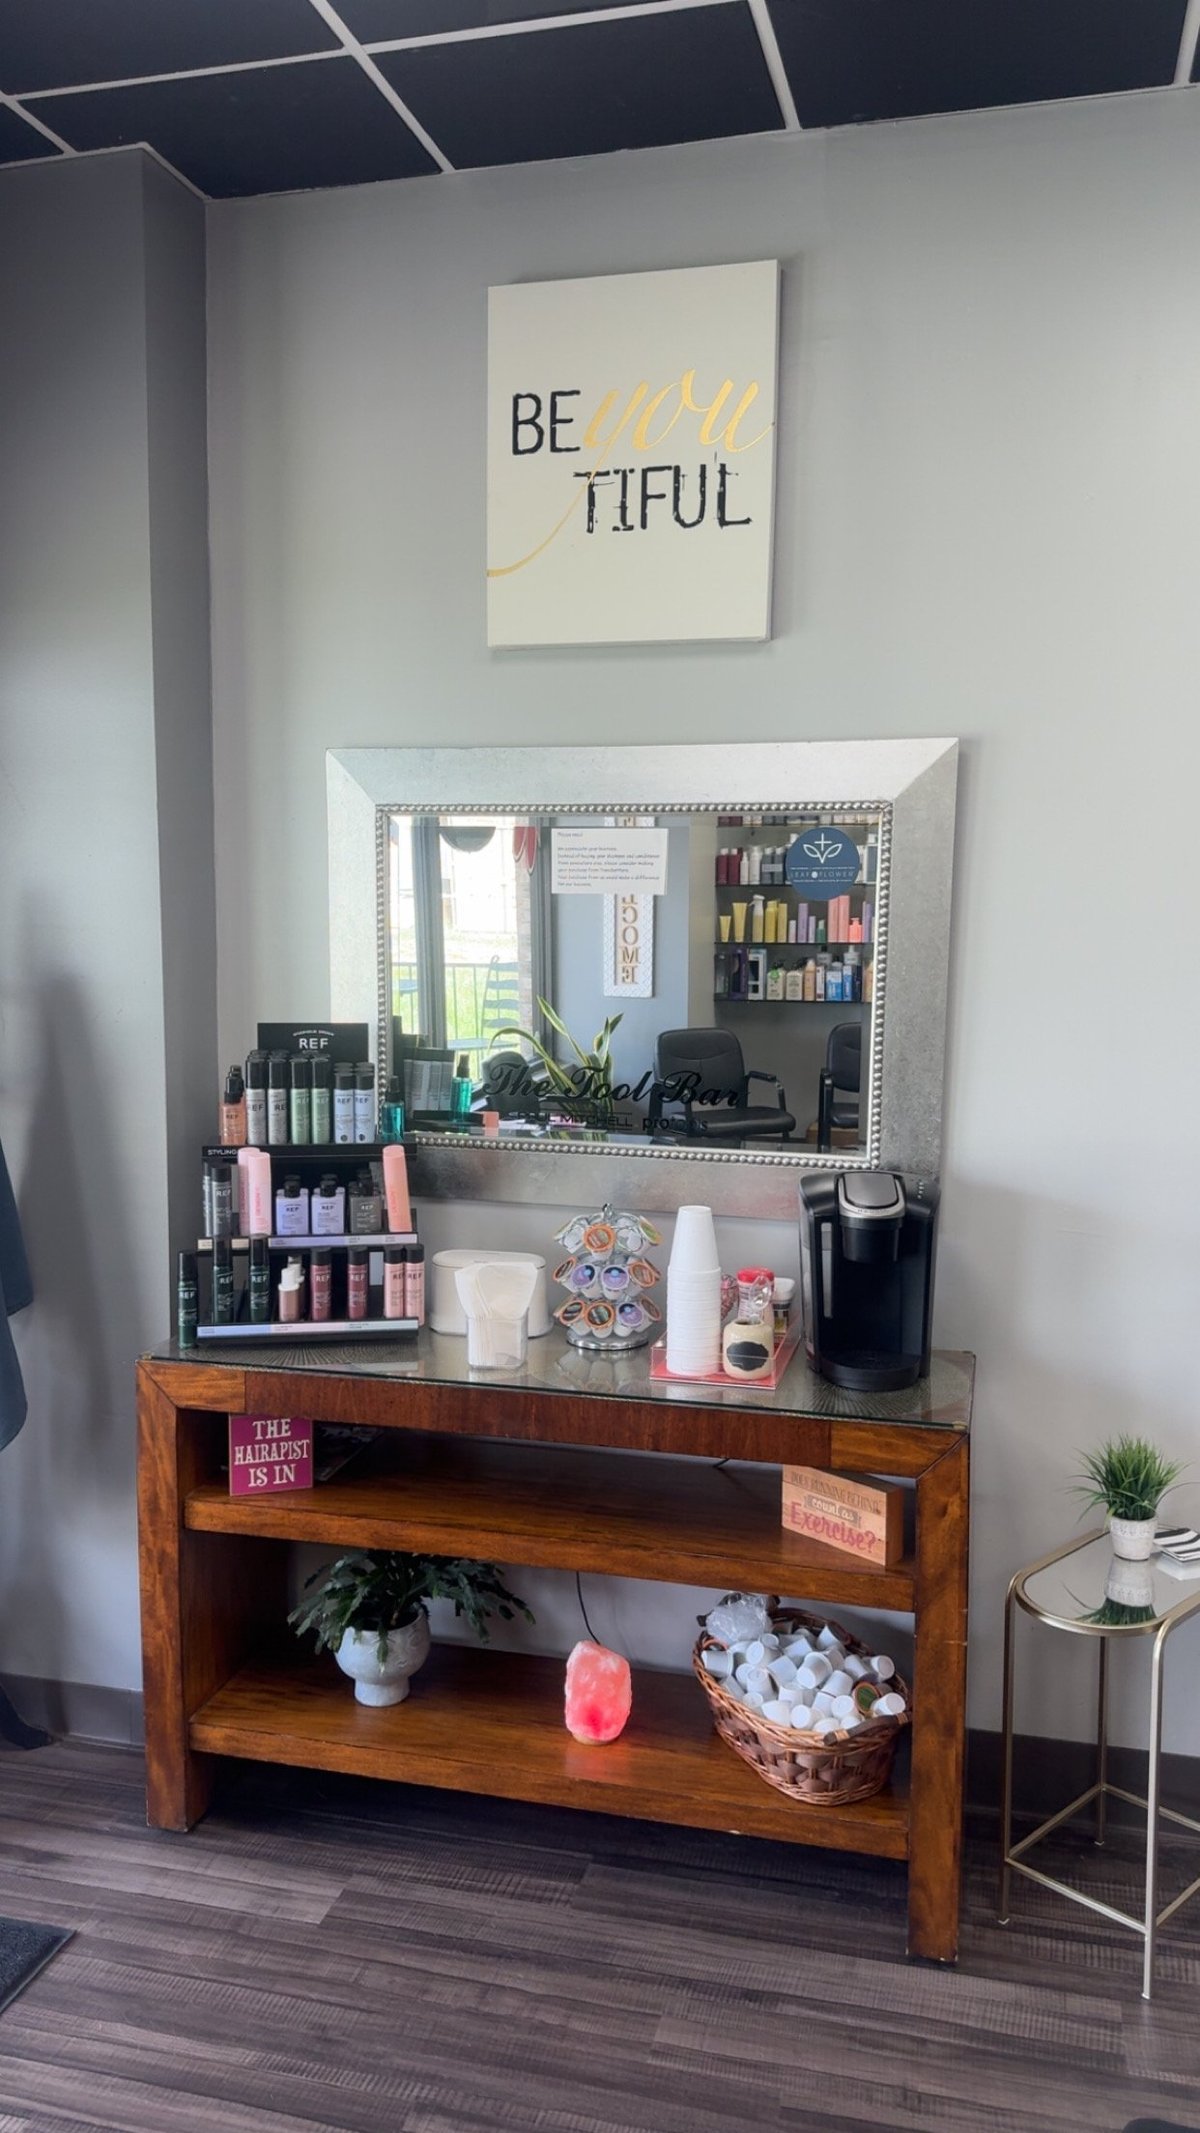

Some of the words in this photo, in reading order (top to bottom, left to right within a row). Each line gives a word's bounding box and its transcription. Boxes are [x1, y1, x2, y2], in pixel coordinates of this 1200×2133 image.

[512, 390, 581, 455] BE
[573, 463, 752, 533] TIFUL
[299, 1038, 328, 1049] REF
[483, 1060, 553, 1097] The
[564, 1065, 652, 1103] Tool
[655, 1070, 741, 1107] Bar
[560, 1112, 632, 1126] MITCHELL
[316, 1274, 330, 1282] REF
[252, 1418, 291, 1440] THE
[234, 1439, 310, 1465] HAIRAPIST
[248, 1466, 268, 1487] IS
[273, 1463, 297, 1484] IN
[811, 1498, 840, 1517] count
[841, 1509, 855, 1521] as
[790, 1501, 876, 1553] Exercise?
